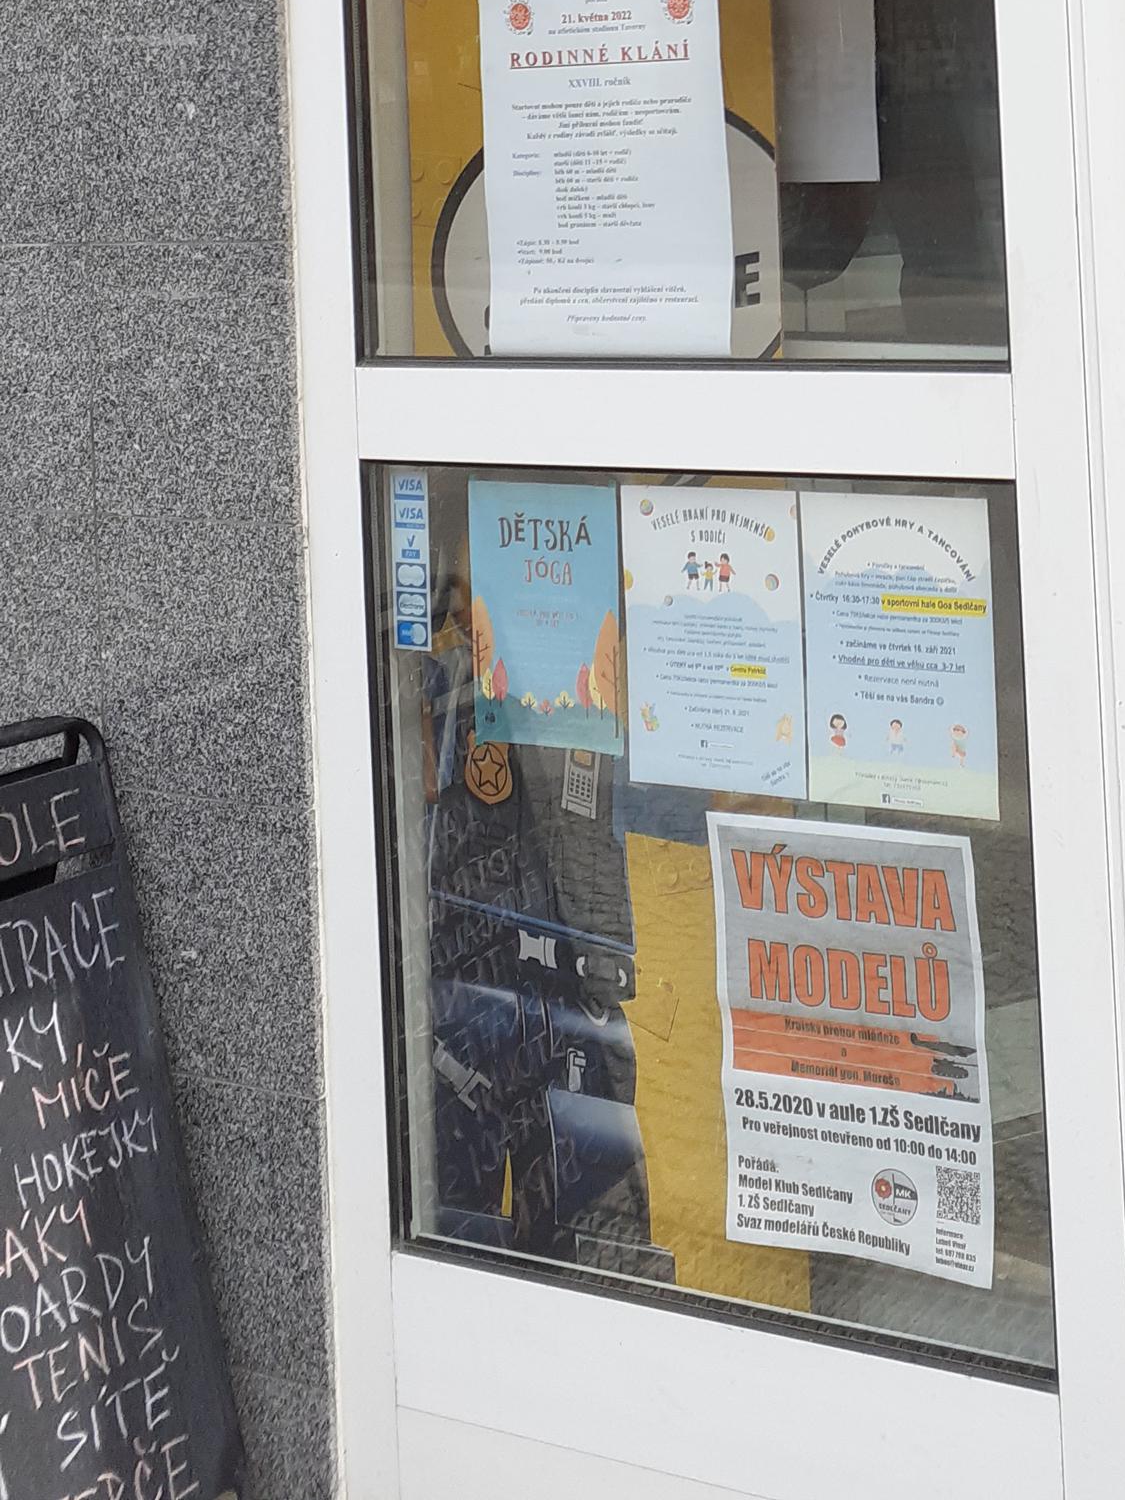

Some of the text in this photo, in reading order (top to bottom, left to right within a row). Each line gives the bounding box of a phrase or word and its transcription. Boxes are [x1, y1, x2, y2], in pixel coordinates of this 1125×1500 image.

[561, 10, 632, 24] 21. května 2022
[510, 39, 690, 68] RODINNÉ KLÁNÍ
[604, 76, 631, 86] ročník
[398, 479, 422, 492] VISA
[399, 508, 423, 519] VISA
[651, 507, 770, 538] VESELÉ HRANÍ PRO NEJMENŠÍ
[498, 513, 591, 551] DĚTSKÁ
[691, 531, 695, 542] S
[818, 539, 842, 575] VESELÉ
[841, 516, 891, 542] POHYBOVÉ
[895, 519, 914, 530] HRY
[927, 531, 975, 582] TANCOVÁNÍ
[525, 557, 572, 585] JÓGA
[815, 591, 838, 604] Čtvrtky
[887, 598, 919, 609] sportovní
[921, 601, 936, 609] hale
[954, 602, 986, 613] Sedlčany
[846, 640, 877, 649] začínáme
[838, 655, 865, 664] Vhodné
[868, 658, 879, 666] pro
[881, 658, 895, 667] děti
[864, 675, 899, 684] Rezervace
[901, 677, 916, 685] není
[731, 844, 957, 932] VÝSTAVA
[748, 938, 950, 1022] MODELŮ
[32, 1043, 140, 1129] MÍČE
[734, 1088, 981, 1142] 28.5.2020 v aule 1.ZŠ Sedlčany
[742, 1117, 977, 1165] Pro veřejnost otevřeno od 10:00 do 14:00
[15, 1108, 157, 1209] HOKEJKY
[738, 1174, 852, 1203] Model Klub Sedlčany
[738, 1192, 814, 1217] 1. ZŠ Sedlčany
[737, 1214, 910, 1256] Svaz modelářů České Republiky
[0, 1236, 152, 1352] OARDY
[13, 1299, 163, 1410] TENIS
[57, 1345, 179, 1472] SÍTĚ
